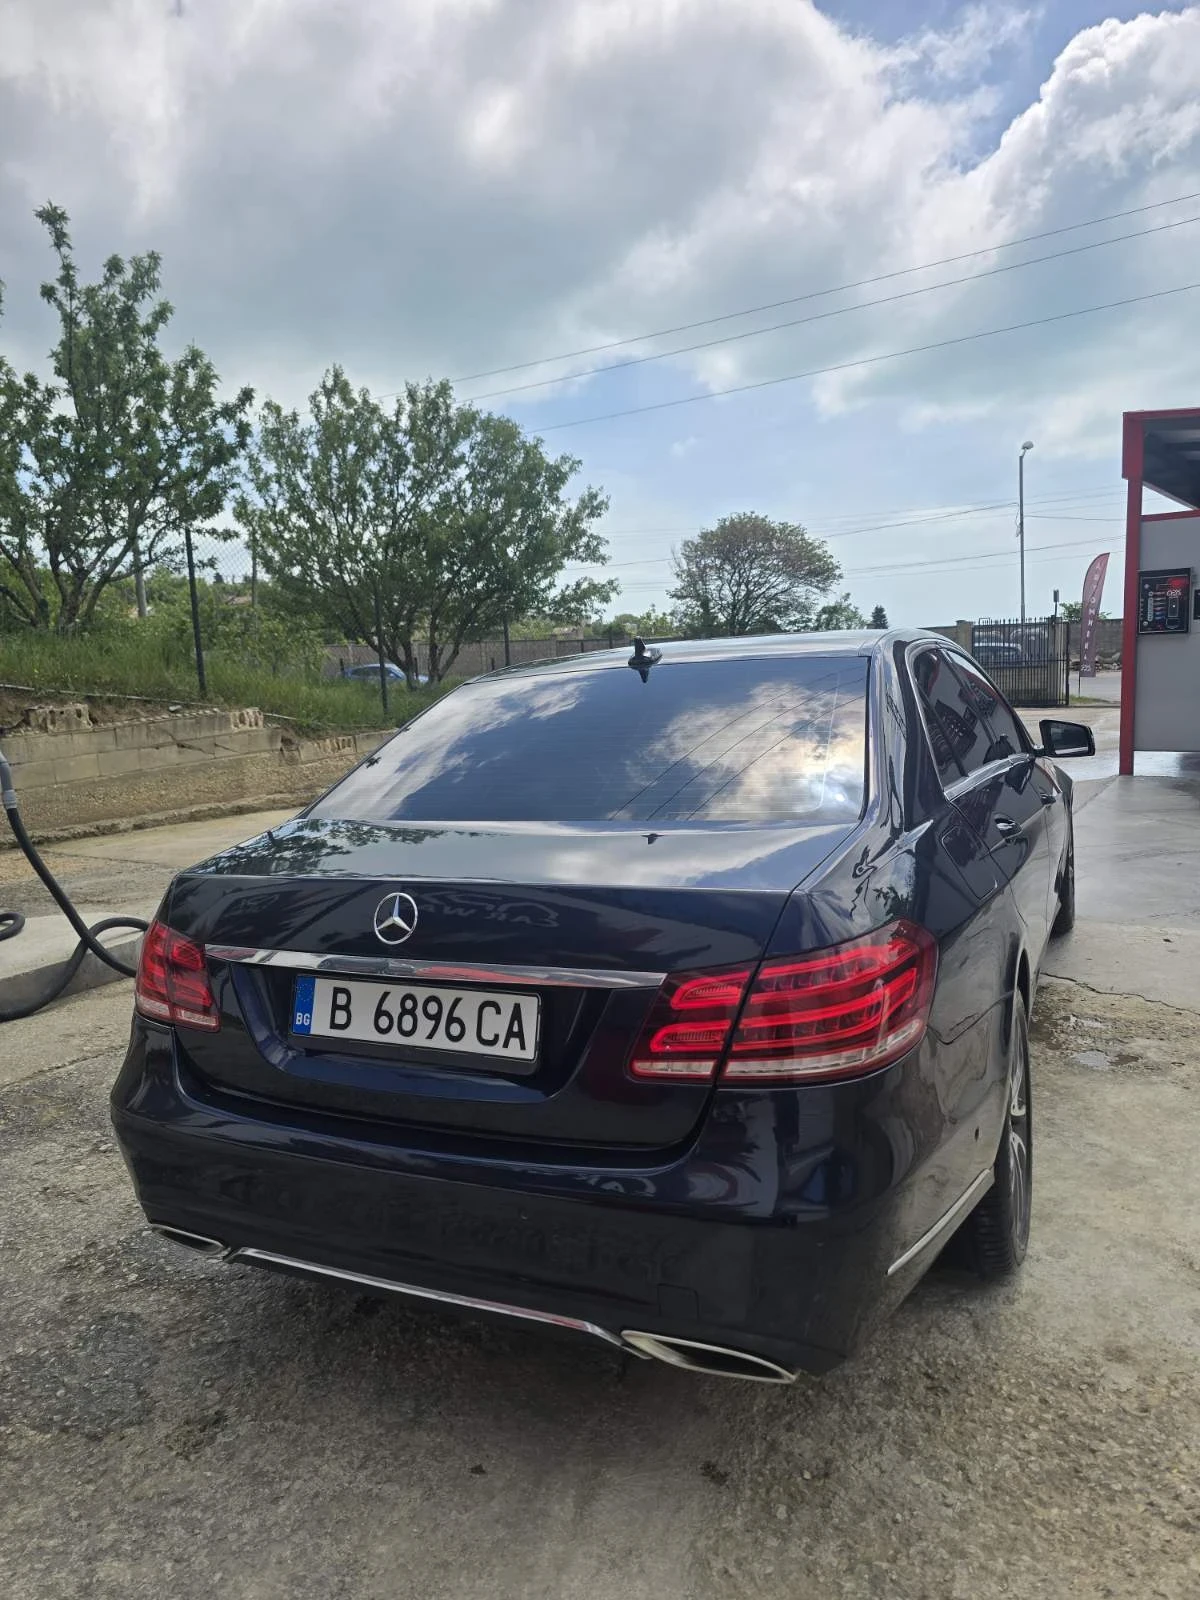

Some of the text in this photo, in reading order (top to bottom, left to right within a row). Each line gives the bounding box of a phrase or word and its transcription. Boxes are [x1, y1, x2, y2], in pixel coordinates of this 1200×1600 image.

[295, 1012, 311, 1026] BG
[329, 986, 527, 1051] B 6896 CA
